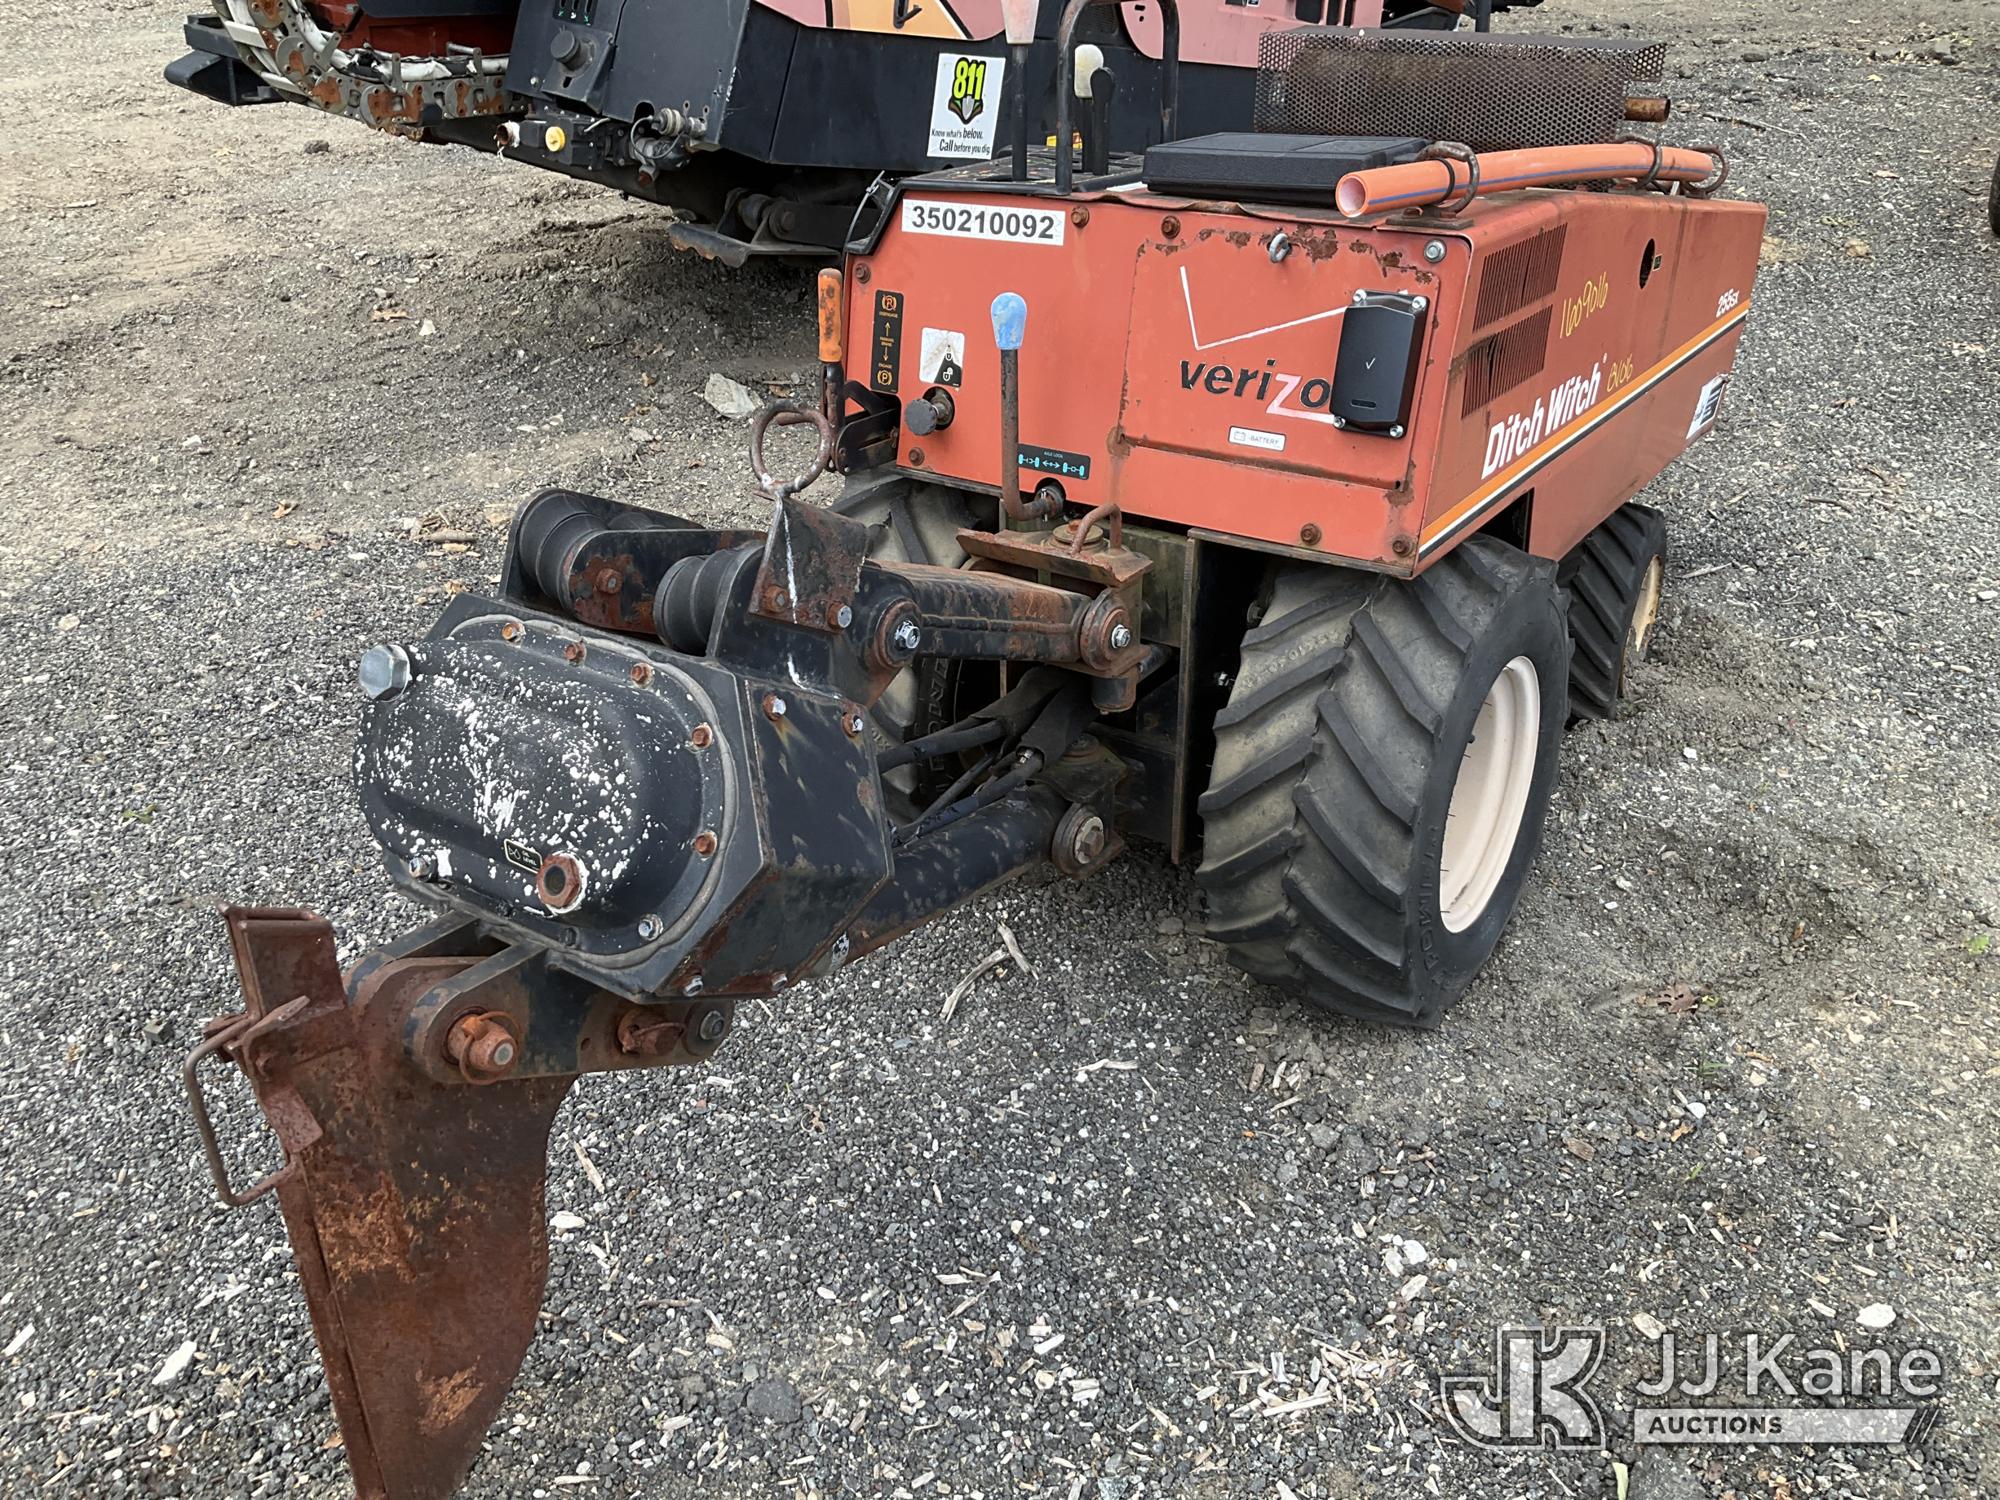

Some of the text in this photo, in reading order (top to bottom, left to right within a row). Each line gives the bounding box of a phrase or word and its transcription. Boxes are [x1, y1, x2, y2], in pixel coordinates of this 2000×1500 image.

[953, 59, 985, 100] 811
[931, 128, 945, 137] Know
[946, 129, 962, 138] what's
[939, 139, 954, 152] Call
[954, 143, 971, 153] before
[971, 145, 981, 155] you
[912, 205, 1054, 239] 350210092
[1180, 359, 1334, 424] verizo
[1481, 397, 1545, 480] Ditch
[1545, 361, 1601, 436] Witch
